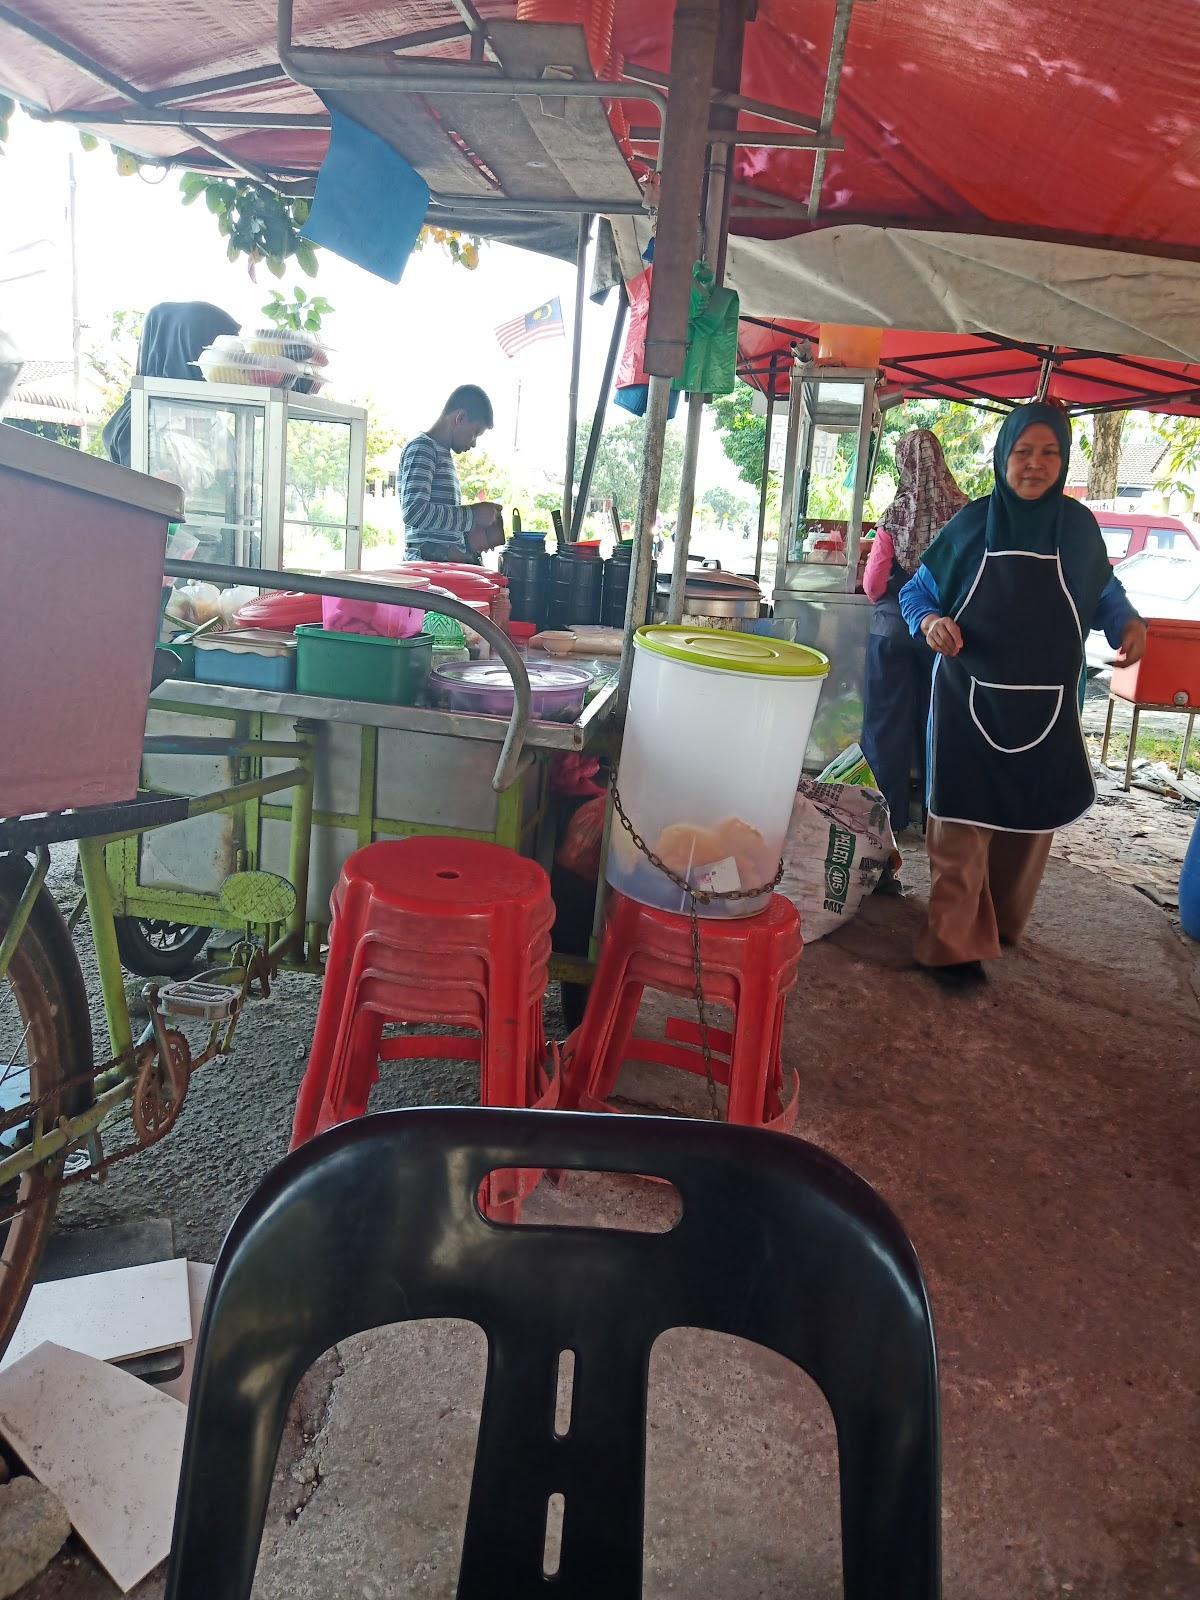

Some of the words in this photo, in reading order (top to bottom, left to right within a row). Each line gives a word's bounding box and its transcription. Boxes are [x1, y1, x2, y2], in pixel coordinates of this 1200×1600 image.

[832, 832, 850, 865] PELLETS
[832, 870, 843, 890] 405
[823, 899, 845, 915] MIX
